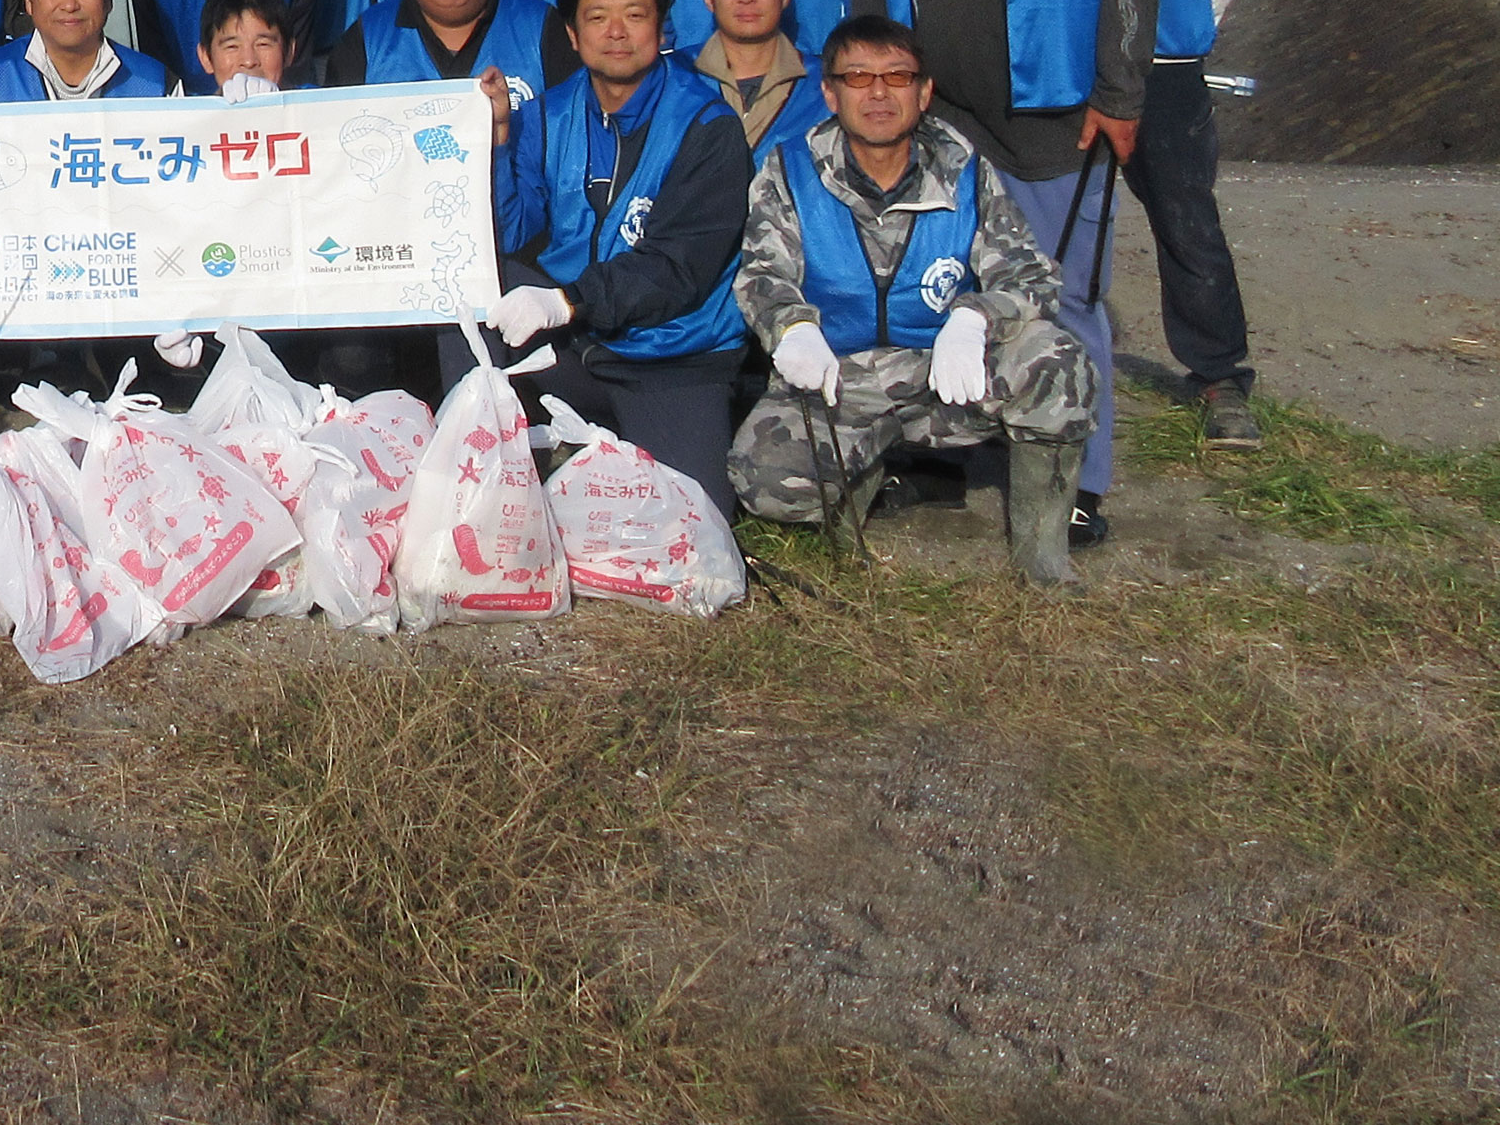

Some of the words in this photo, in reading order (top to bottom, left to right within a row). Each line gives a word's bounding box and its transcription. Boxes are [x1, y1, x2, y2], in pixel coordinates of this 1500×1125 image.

[50, 131, 311, 188] 海ごみゼロ
[3, 235, 38, 252] 日本
[44, 232, 137, 252] CHANGE
[88, 254, 112, 265] FOR
[116, 253, 137, 265] THE
[238, 244, 292, 259] Plastics
[355, 243, 414, 263] 環境省
[239, 260, 281, 273] Smart
[309, 265, 342, 274] Ministry
[353, 264, 365, 272] the
[366, 262, 416, 272] Environment
[89, 267, 138, 287] BLUE
